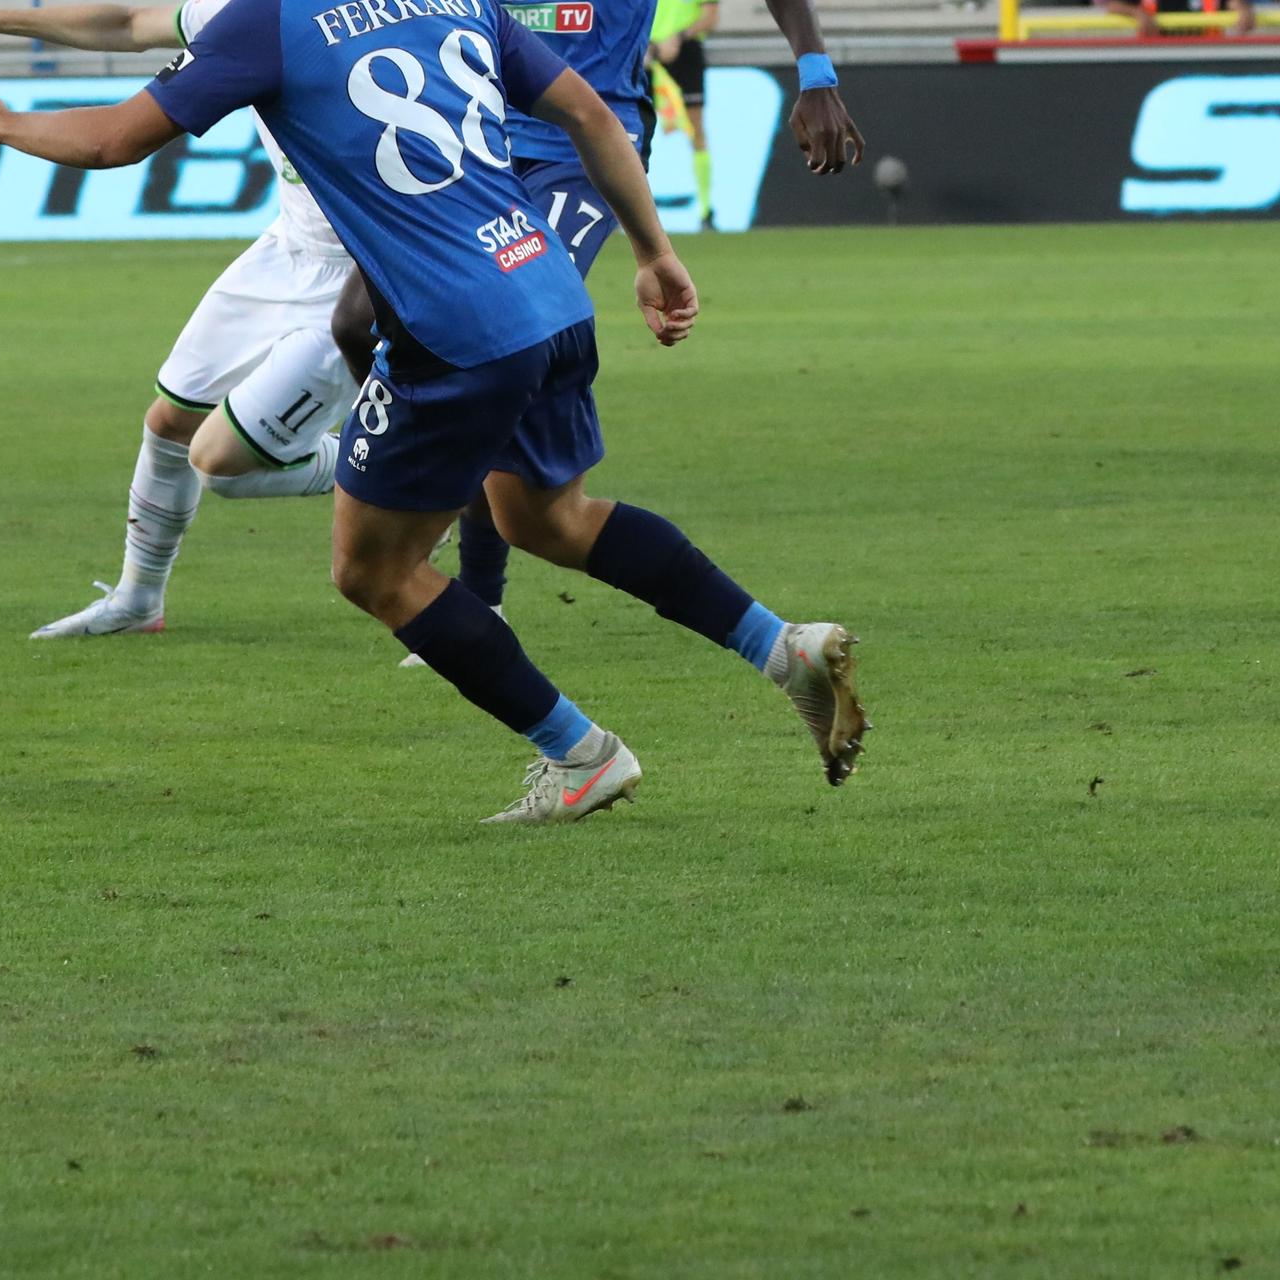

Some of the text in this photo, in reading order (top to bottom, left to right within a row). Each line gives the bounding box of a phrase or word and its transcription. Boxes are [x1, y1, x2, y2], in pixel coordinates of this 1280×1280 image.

[560, 7, 589, 26] TV
[346, 28, 512, 196] 88
[476, 209, 537, 254] STAR
[547, 191, 604, 248] 17
[499, 236, 543, 268] CASINO
[274, 388, 324, 434] 11
[352, 378, 394, 436] 8
[347, 455, 367, 472] MILLS
